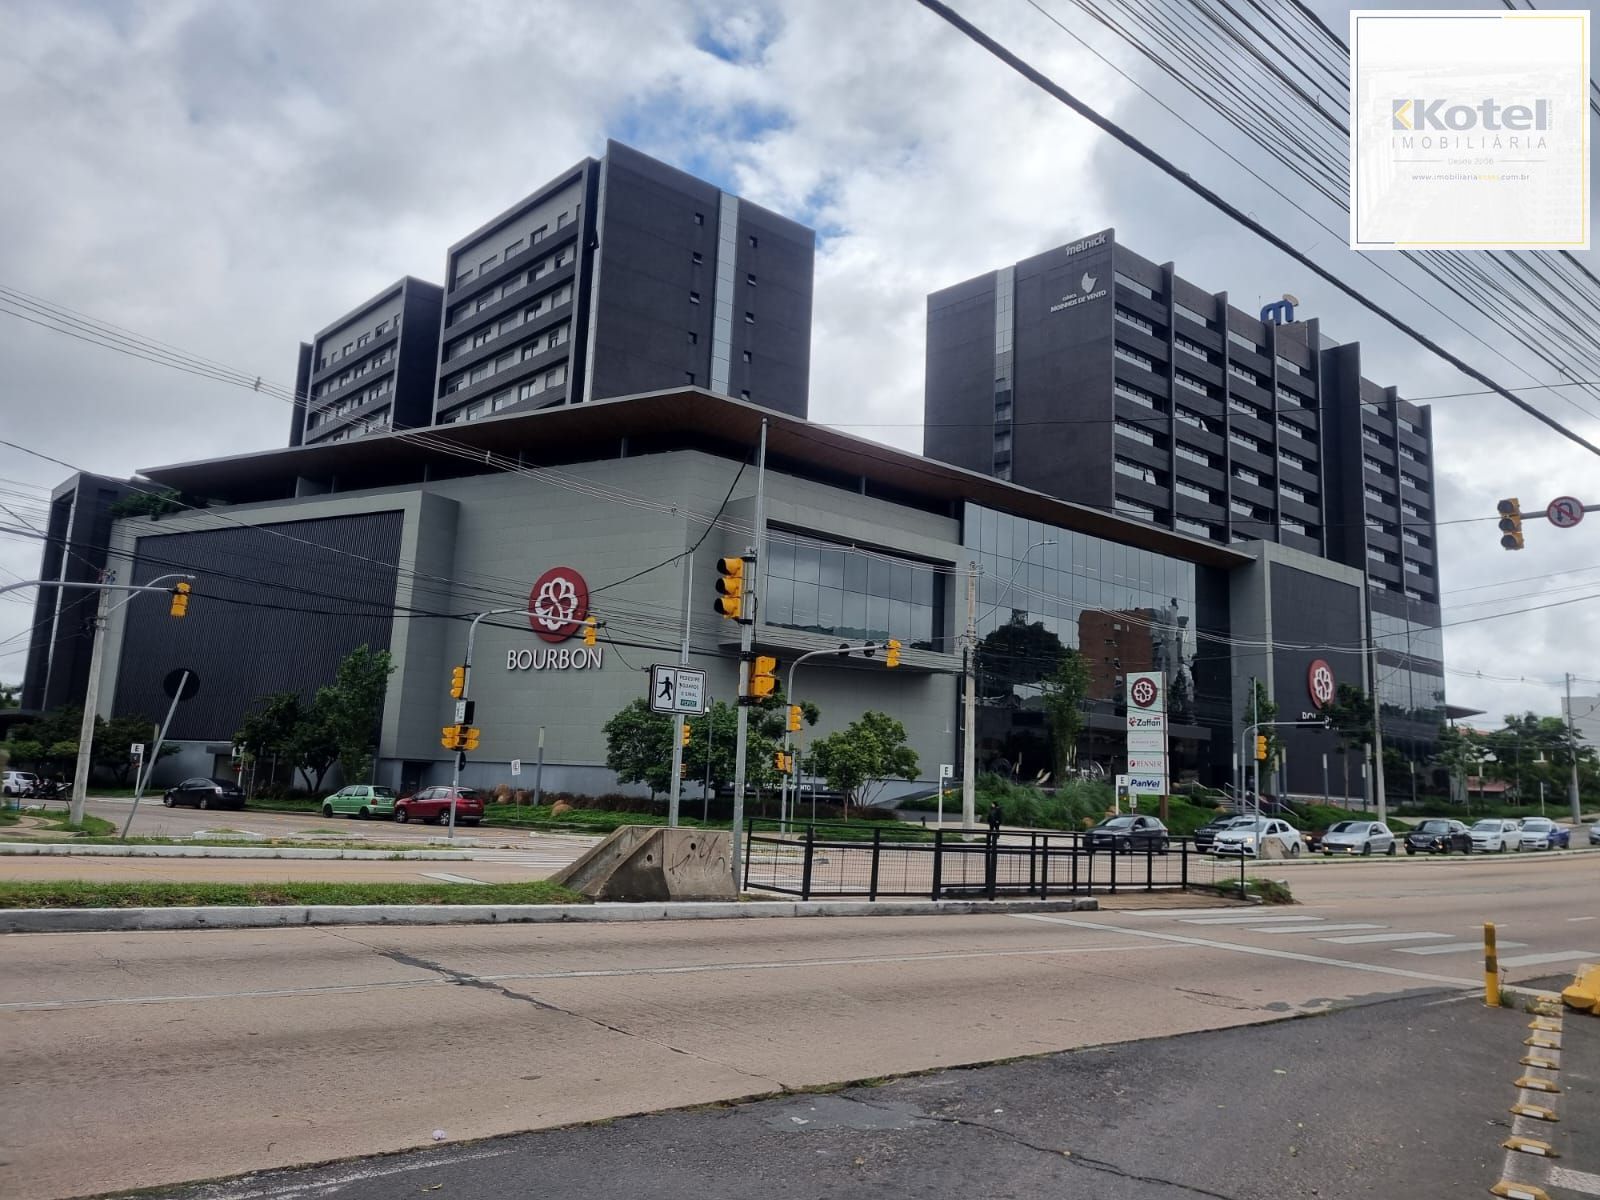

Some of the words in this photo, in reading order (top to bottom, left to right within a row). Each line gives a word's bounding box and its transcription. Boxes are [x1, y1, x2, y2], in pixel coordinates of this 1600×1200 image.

[1066, 234, 1106, 256] melnick
[1087, 290, 1106, 301] VENTO
[507, 648, 603, 669] BOURBON
[1136, 759, 1162, 769] RENNER
[944, 767, 949, 776] E
[1121, 776, 1125, 784] E
[1130, 778, 1160, 788] PanVel
